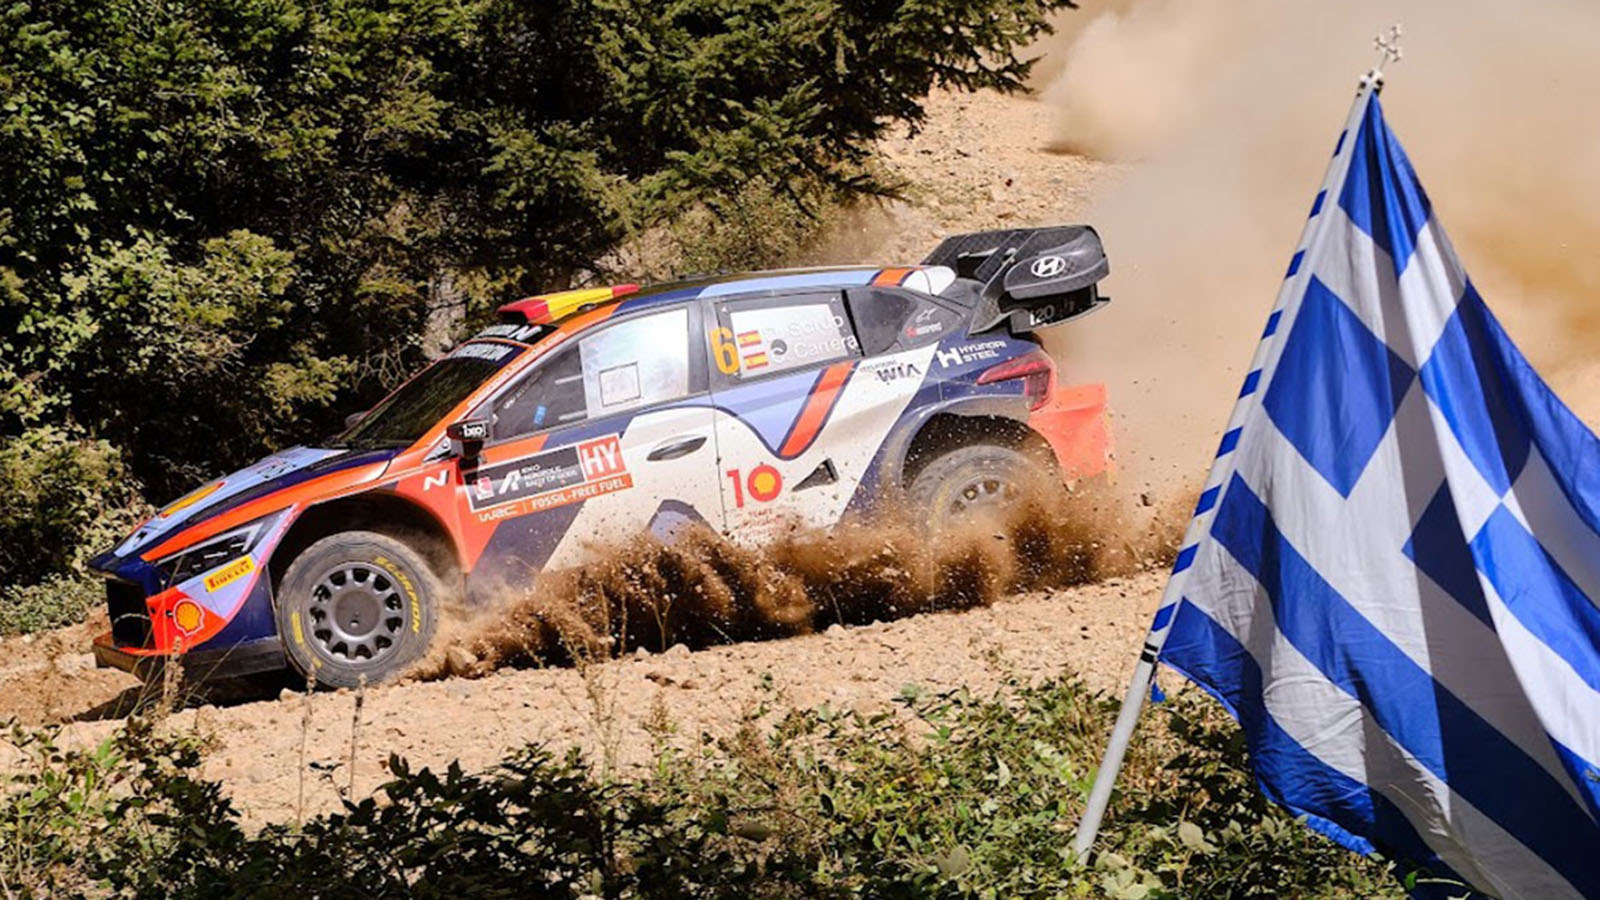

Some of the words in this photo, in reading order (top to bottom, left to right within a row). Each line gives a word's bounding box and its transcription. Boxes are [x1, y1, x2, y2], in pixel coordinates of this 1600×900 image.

[710, 326, 740, 375] 6
[959, 340, 1007, 354] HYUNDAI
[963, 350, 999, 362] STEEL
[876, 363, 921, 383] WIA
[580, 441, 618, 477] HY
[600, 478, 627, 492] FUEL
